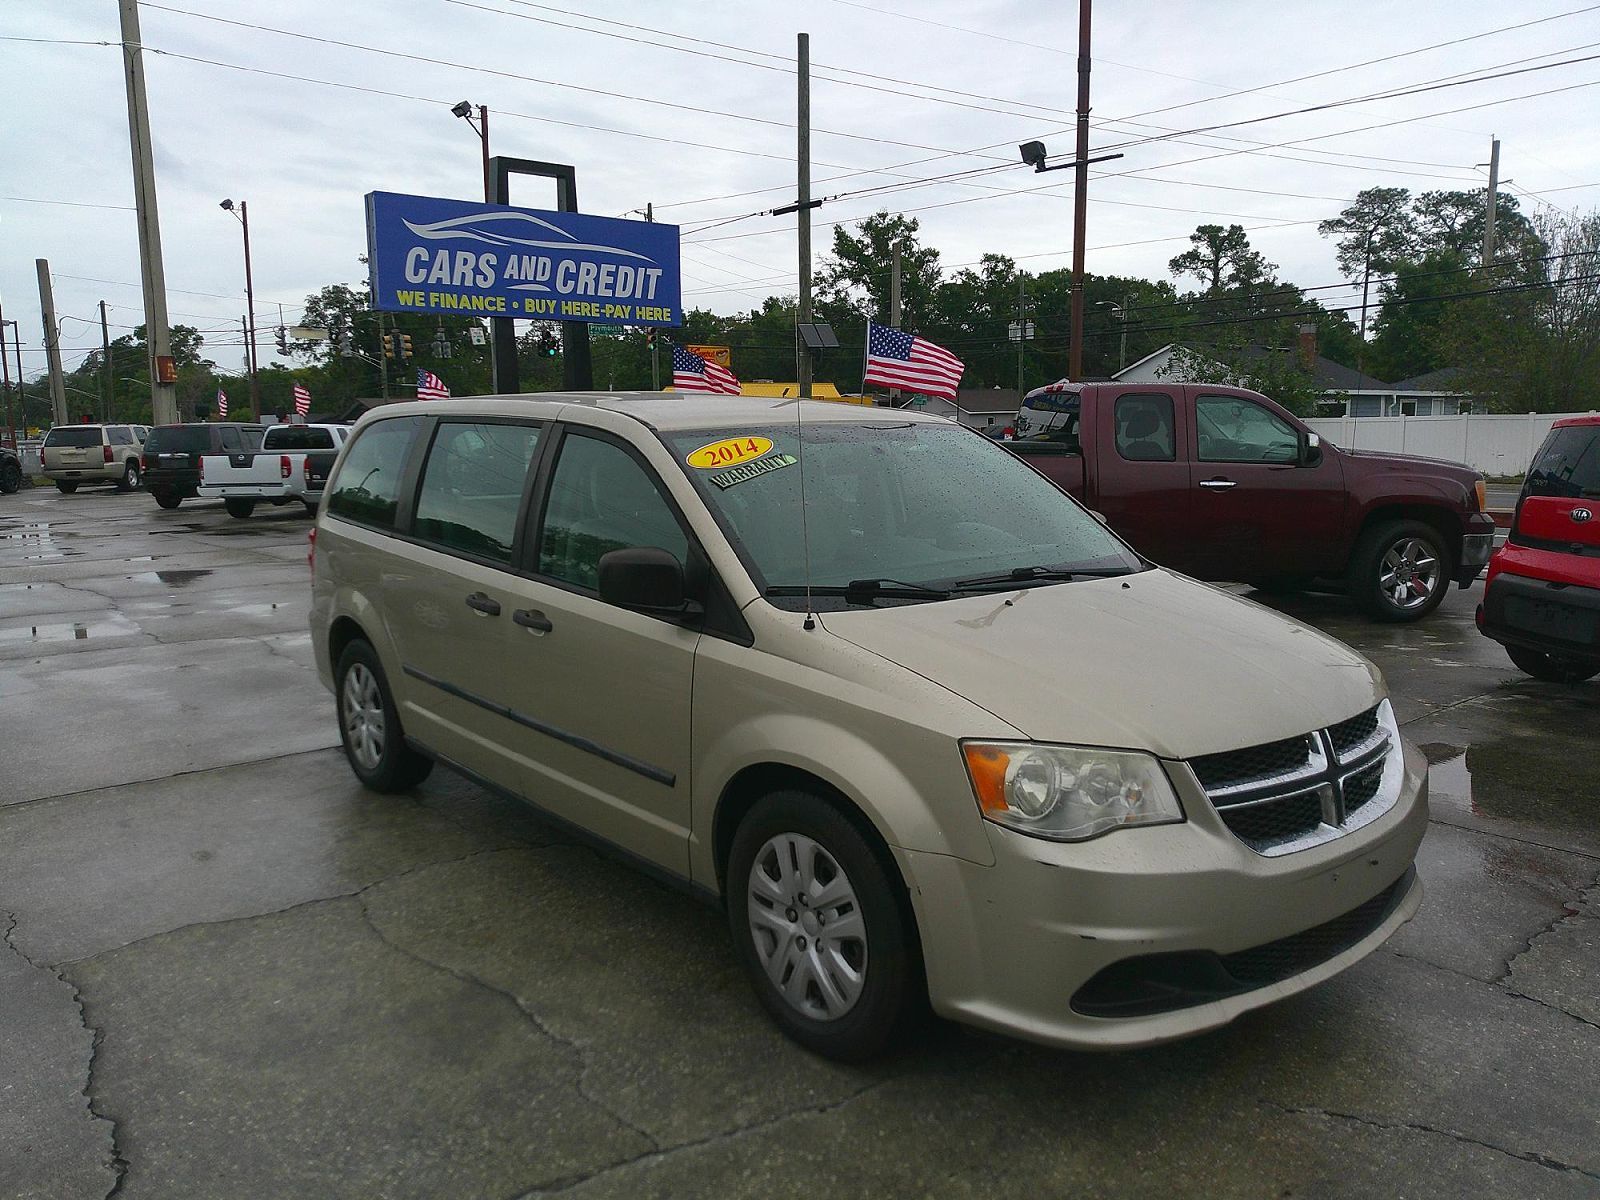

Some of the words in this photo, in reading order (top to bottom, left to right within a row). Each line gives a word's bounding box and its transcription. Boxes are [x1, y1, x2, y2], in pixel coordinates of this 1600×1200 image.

[405, 246, 498, 289] CARS
[503, 254, 552, 282] AND
[555, 259, 663, 300] CREDIT
[397, 290, 426, 307] WE
[429, 292, 506, 312] FINANCE
[525, 297, 557, 315] BUY
[561, 300, 632, 319] HERE-PAY
[635, 306, 672, 321] HERE
[704, 438, 758, 466] 2014
[712, 454, 787, 488] WARRANTY
[1572, 510, 1588, 520] KIA
